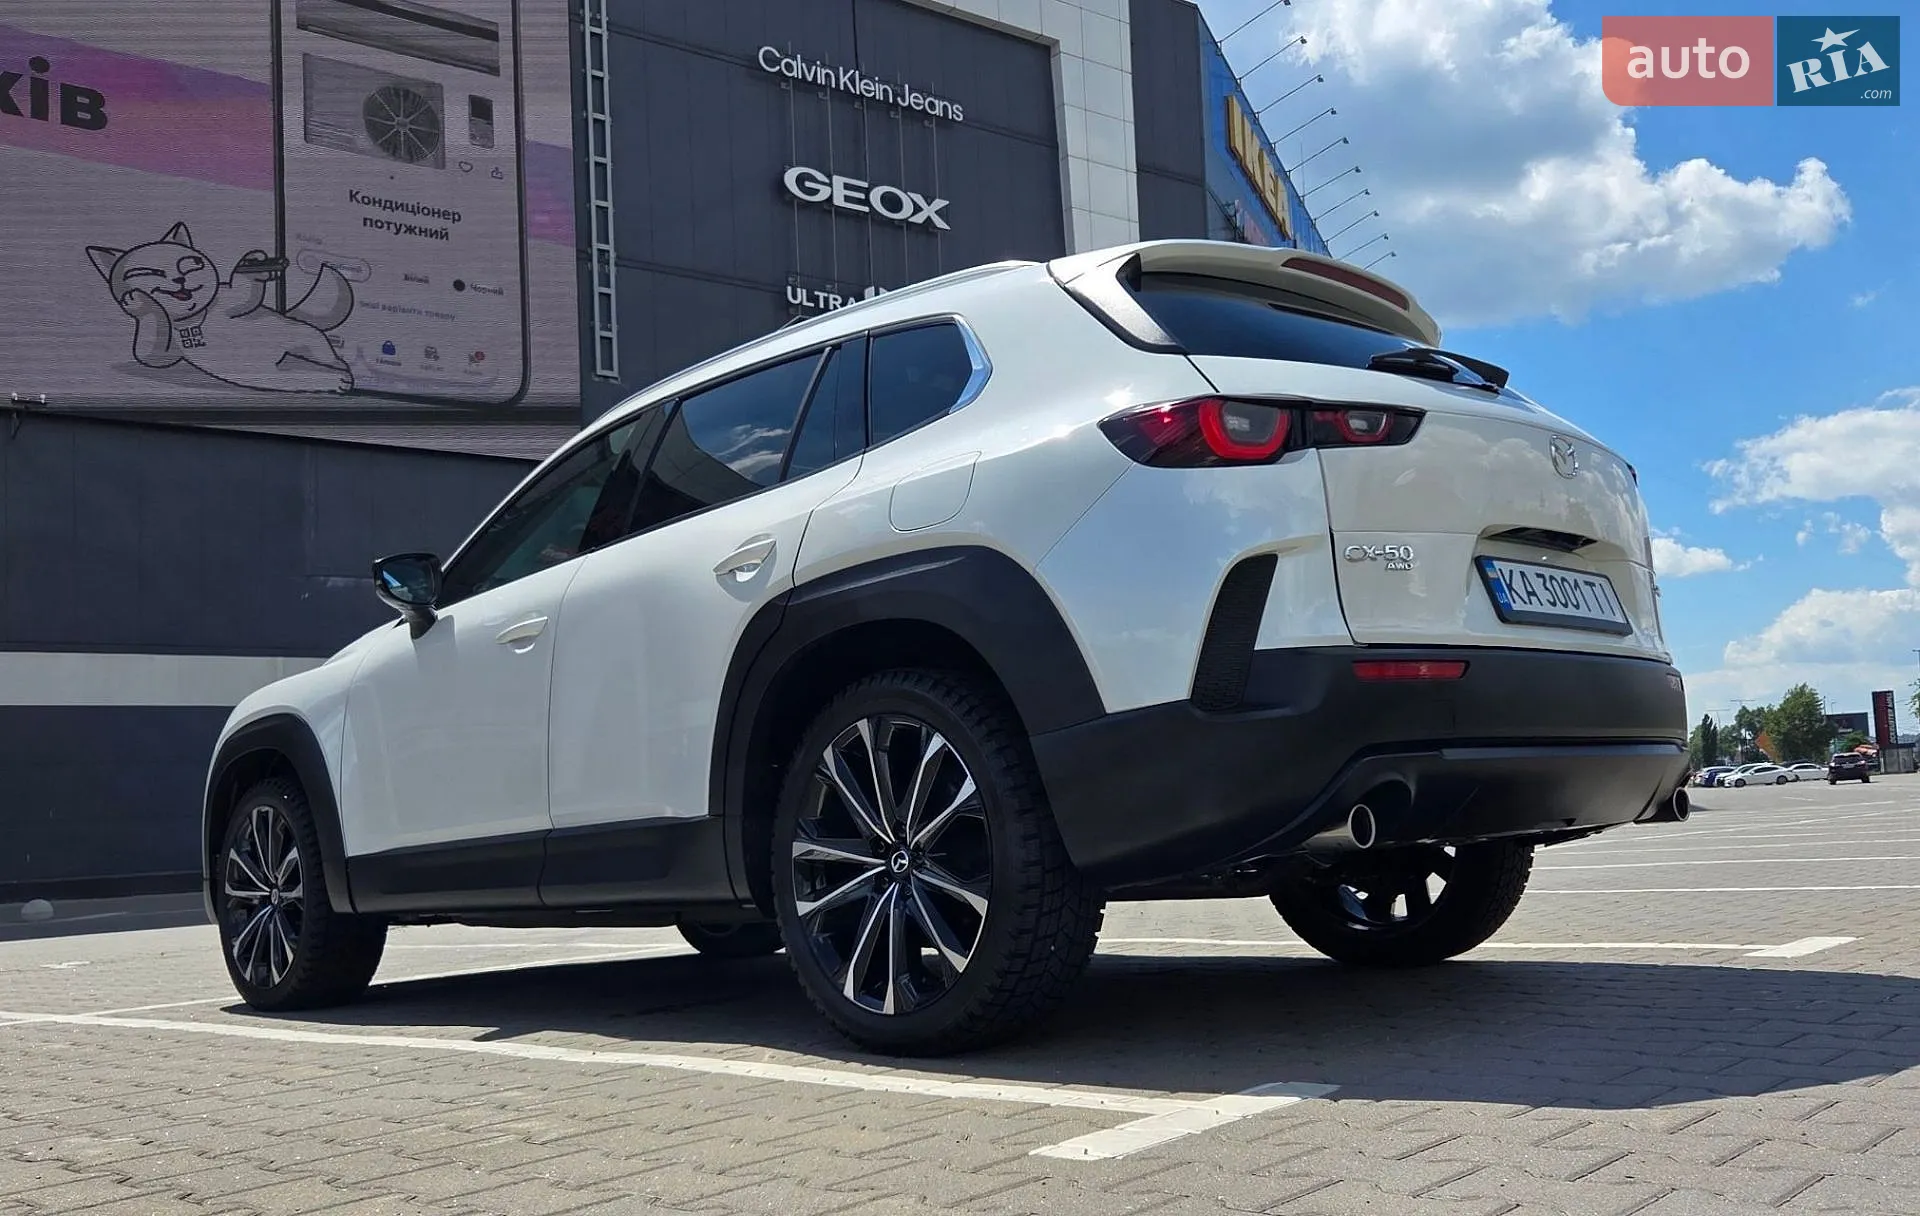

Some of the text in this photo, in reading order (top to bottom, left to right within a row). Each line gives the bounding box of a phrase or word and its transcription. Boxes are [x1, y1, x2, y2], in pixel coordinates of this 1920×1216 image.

[758, 46, 964, 121] Calvin Klein Jeans
[349, 189, 462, 225] Кондиціонер
[783, 166, 951, 230] GEOX
[362, 216, 449, 241] потужний
[1344, 545, 1414, 562] CX-50
[1386, 562, 1414, 571] AWD
